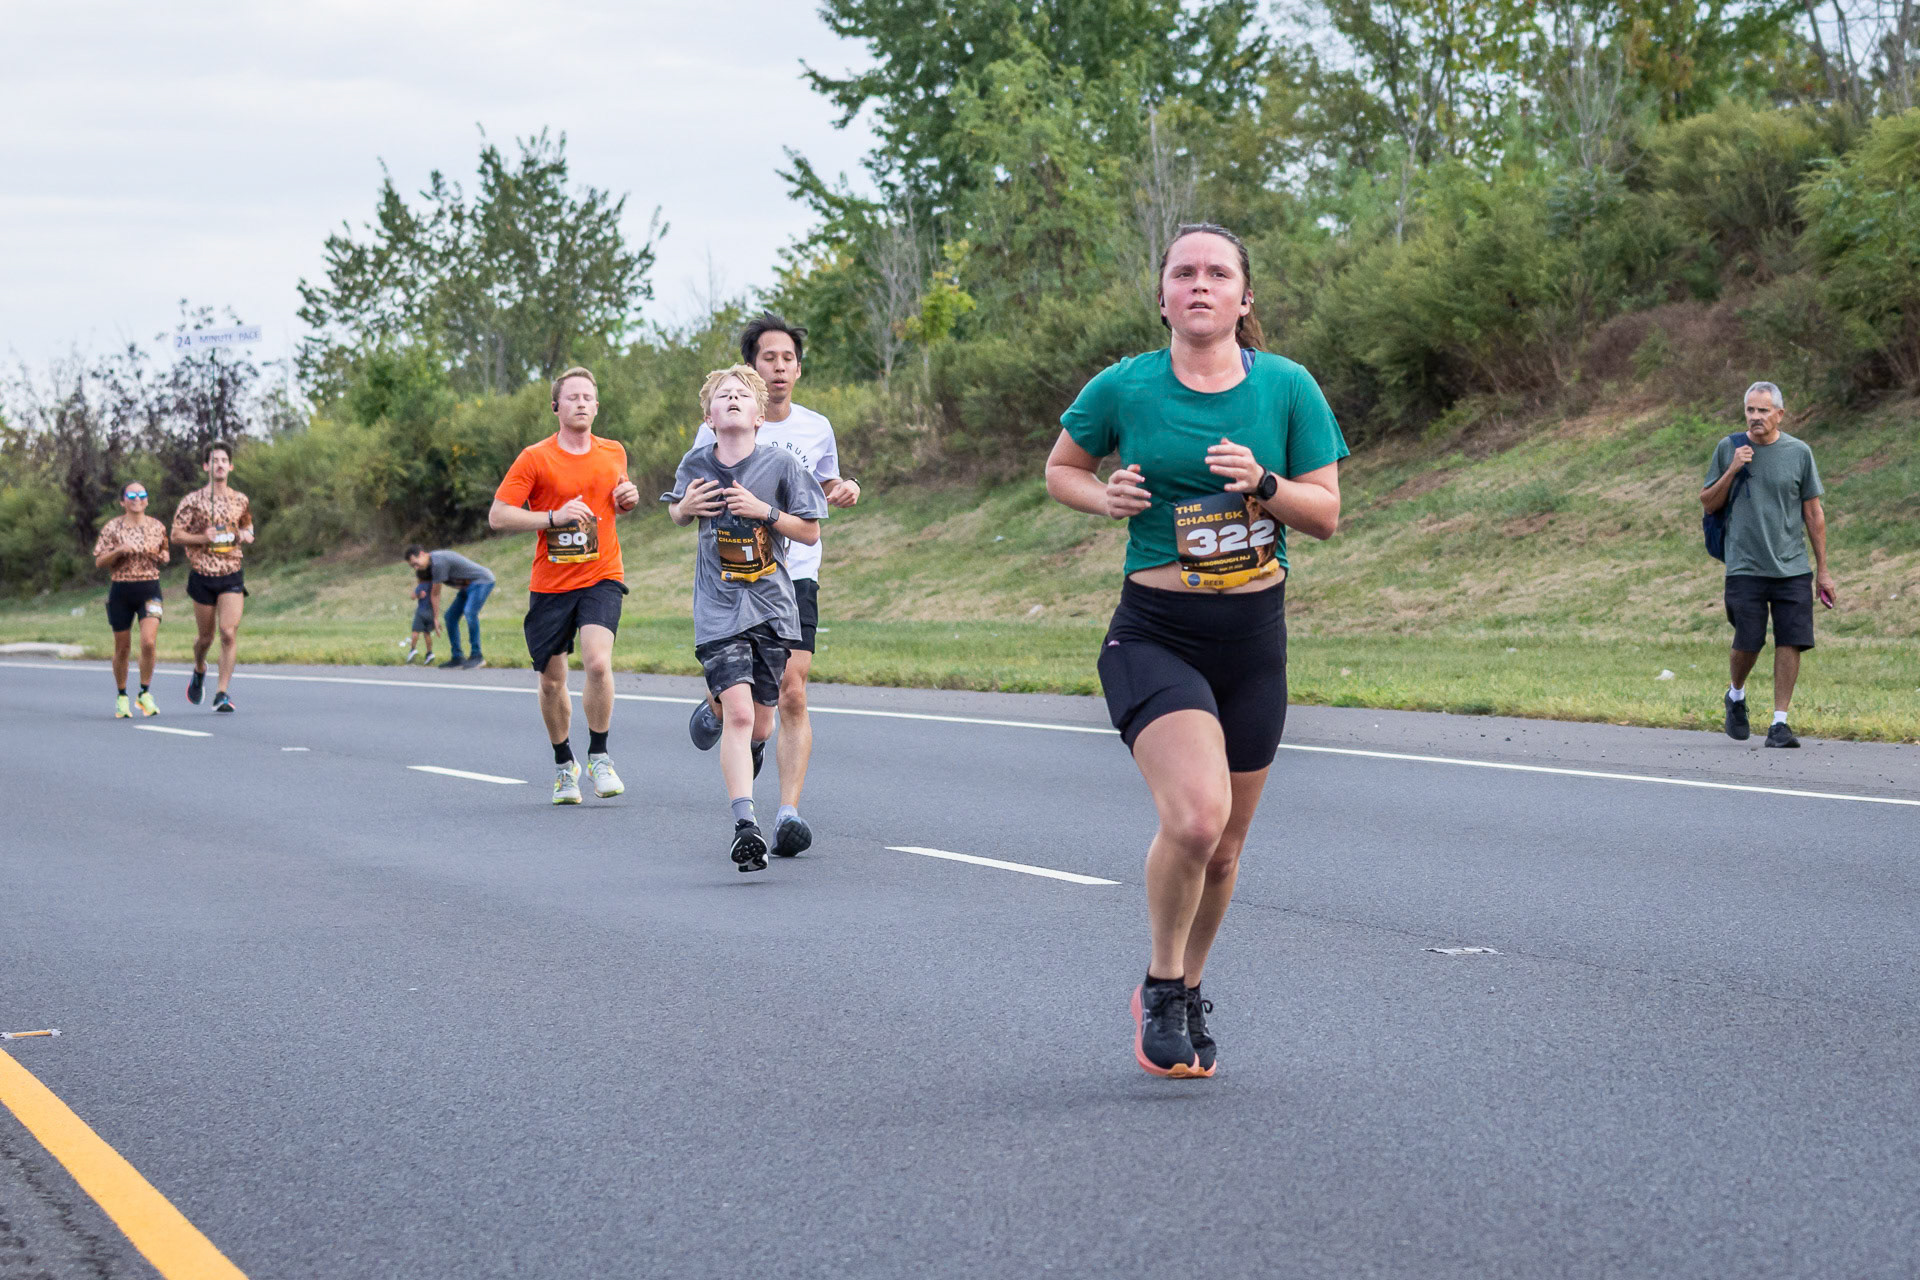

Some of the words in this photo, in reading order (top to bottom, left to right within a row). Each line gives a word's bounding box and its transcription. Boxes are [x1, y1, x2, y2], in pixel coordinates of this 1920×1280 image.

[177, 336, 191, 348] 24
[1176, 503, 1202, 514] THE
[1177, 513, 1223, 526] CHASE
[1225, 510, 1244, 520] 5K
[558, 532, 588, 546] 90
[1187, 519, 1275, 556] 322
[741, 545, 754, 562] 1
